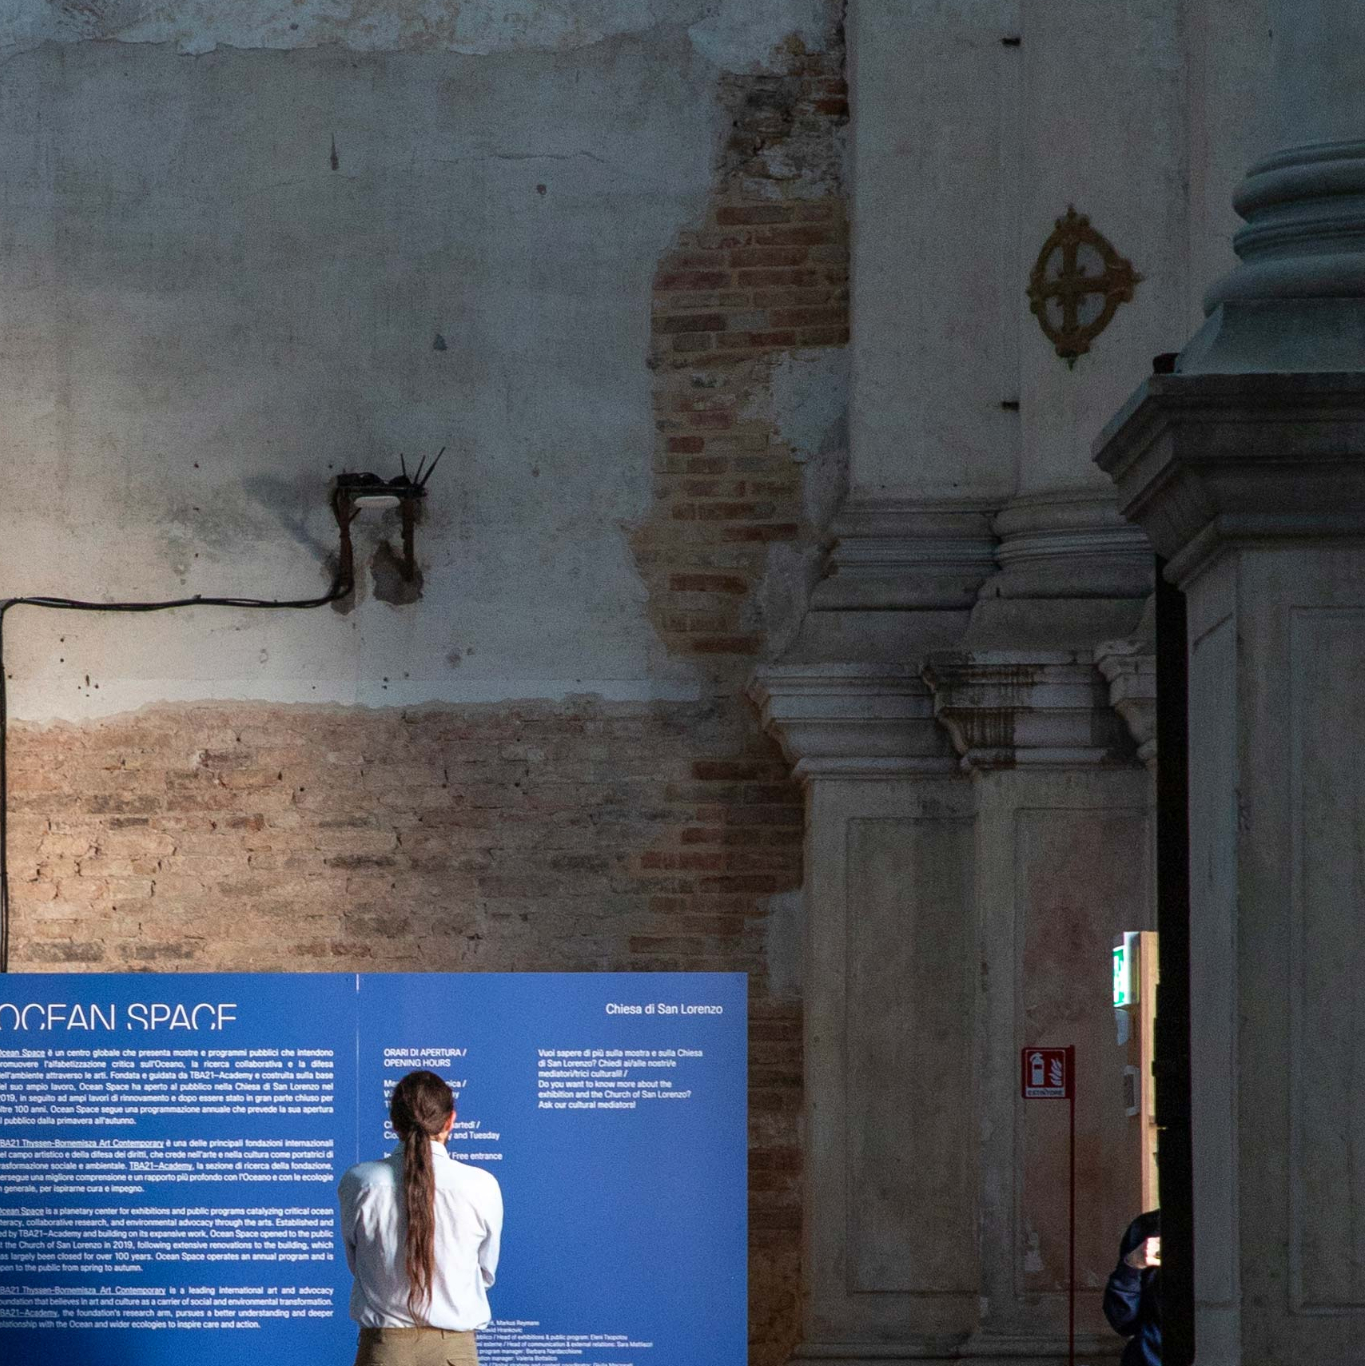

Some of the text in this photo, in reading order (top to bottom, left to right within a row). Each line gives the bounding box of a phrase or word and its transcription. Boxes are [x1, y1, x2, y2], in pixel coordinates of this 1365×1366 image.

[606, 1004, 723, 1014] Chiesa di San Lorenzo
[127, 1003, 238, 1030] SPACE
[22, 1049, 46, 1057] Space
[47, 1049, 52, 1057] è
[66, 1049, 90, 1057] centro
[92, 1049, 120, 1059] globale
[122, 1049, 136, 1057] che
[138, 1049, 171, 1059] presenta
[172, 1049, 198, 1057] mostre
[208, 1049, 247, 1059] programmi
[249, 1049, 279, 1059] pubblici
[280, 1049, 295, 1057] che
[297, 1049, 334, 1057] intendono
[384, 1049, 408, 1057] ORARI
[410, 1049, 418, 1057] DI
[420, 1049, 461, 1057] APERTURA
[538, 1049, 555, 1057] Vuoi
[556, 1051, 582, 1059] sapere
[583, 1049, 591, 1057] di
[592, 1049, 604, 1059] più
[605, 1049, 623, 1057] sulla
[624, 1049, 650, 1057] mostra
[658, 1049, 676, 1057] sulla
[677, 1049, 703, 1057] Chiesa
[384, 1059, 451, 1067] OPENING HOURS
[148, 1072, 176, 1081] guidata
[550, 1082, 564, 1090] you
[538, 1091, 574, 1099] exhibition
[575, 1091, 590, 1099] and
[590, 1091, 603, 1099] the
[604, 1091, 631, 1099] Church
[632, 1091, 640, 1099] of
[641, 1091, 656, 1099] San
[538, 1101, 553, 1109] Ask
[568, 1101, 596, 1109] cultural
[453, 1120, 476, 1129] artedì
[454, 1131, 468, 1139] and
[469, 1131, 500, 1141] Tuesday
[99, 1139, 110, 1147] Art
[165, 1139, 171, 1147] è
[188, 1139, 207, 1147] delle
[452, 1152, 468, 1160] Free
[470, 1152, 503, 1160] entrance
[21, 1207, 44, 1217] Space
[46, 1207, 51, 1215] is
[94, 1207, 118, 1215] center
[119, 1207, 129, 1215] for
[171, 1207, 186, 1215] and
[186, 1207, 209, 1217] public
[210, 1209, 244, 1217] programs
[284, 1207, 310, 1215] critical
